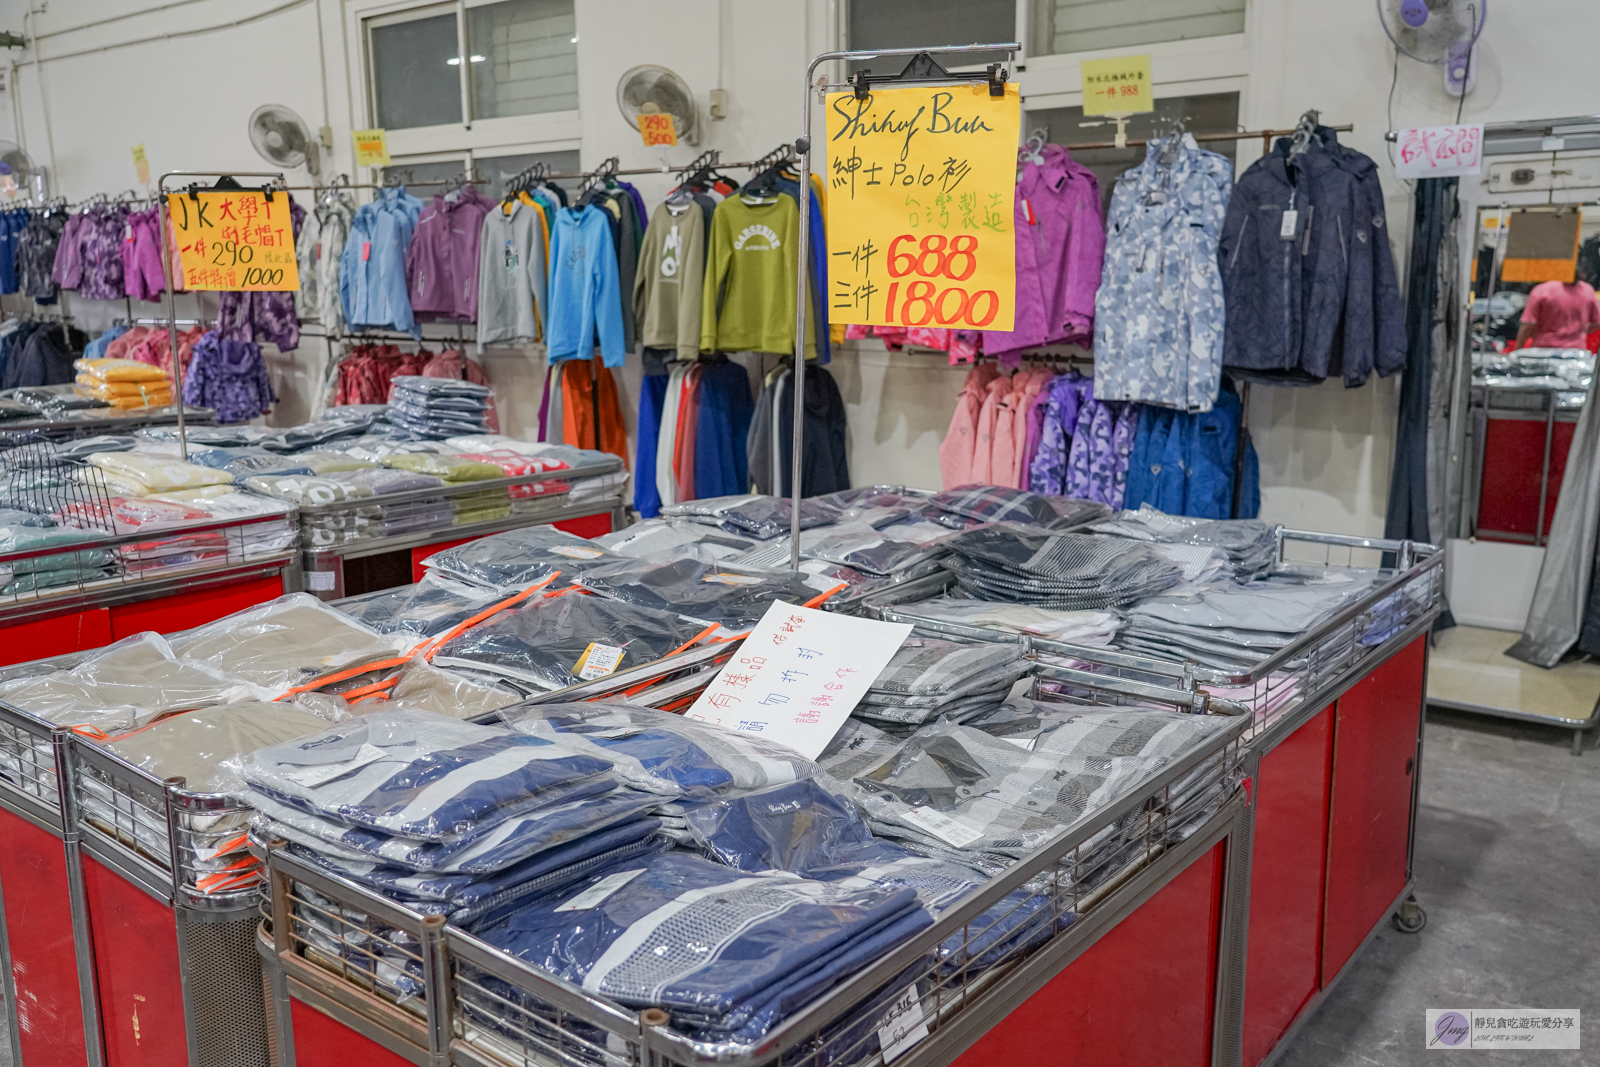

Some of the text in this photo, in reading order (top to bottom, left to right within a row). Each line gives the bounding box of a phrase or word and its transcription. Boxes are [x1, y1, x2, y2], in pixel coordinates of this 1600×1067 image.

[644, 115, 669, 130] 290
[648, 131, 673, 145] 500
[182, 237, 207, 258] 一件
[212, 240, 254, 266] 290
[832, 234, 979, 281] 一件 688
[241, 267, 284, 288] 1000
[833, 280, 999, 327] 三件 1800
